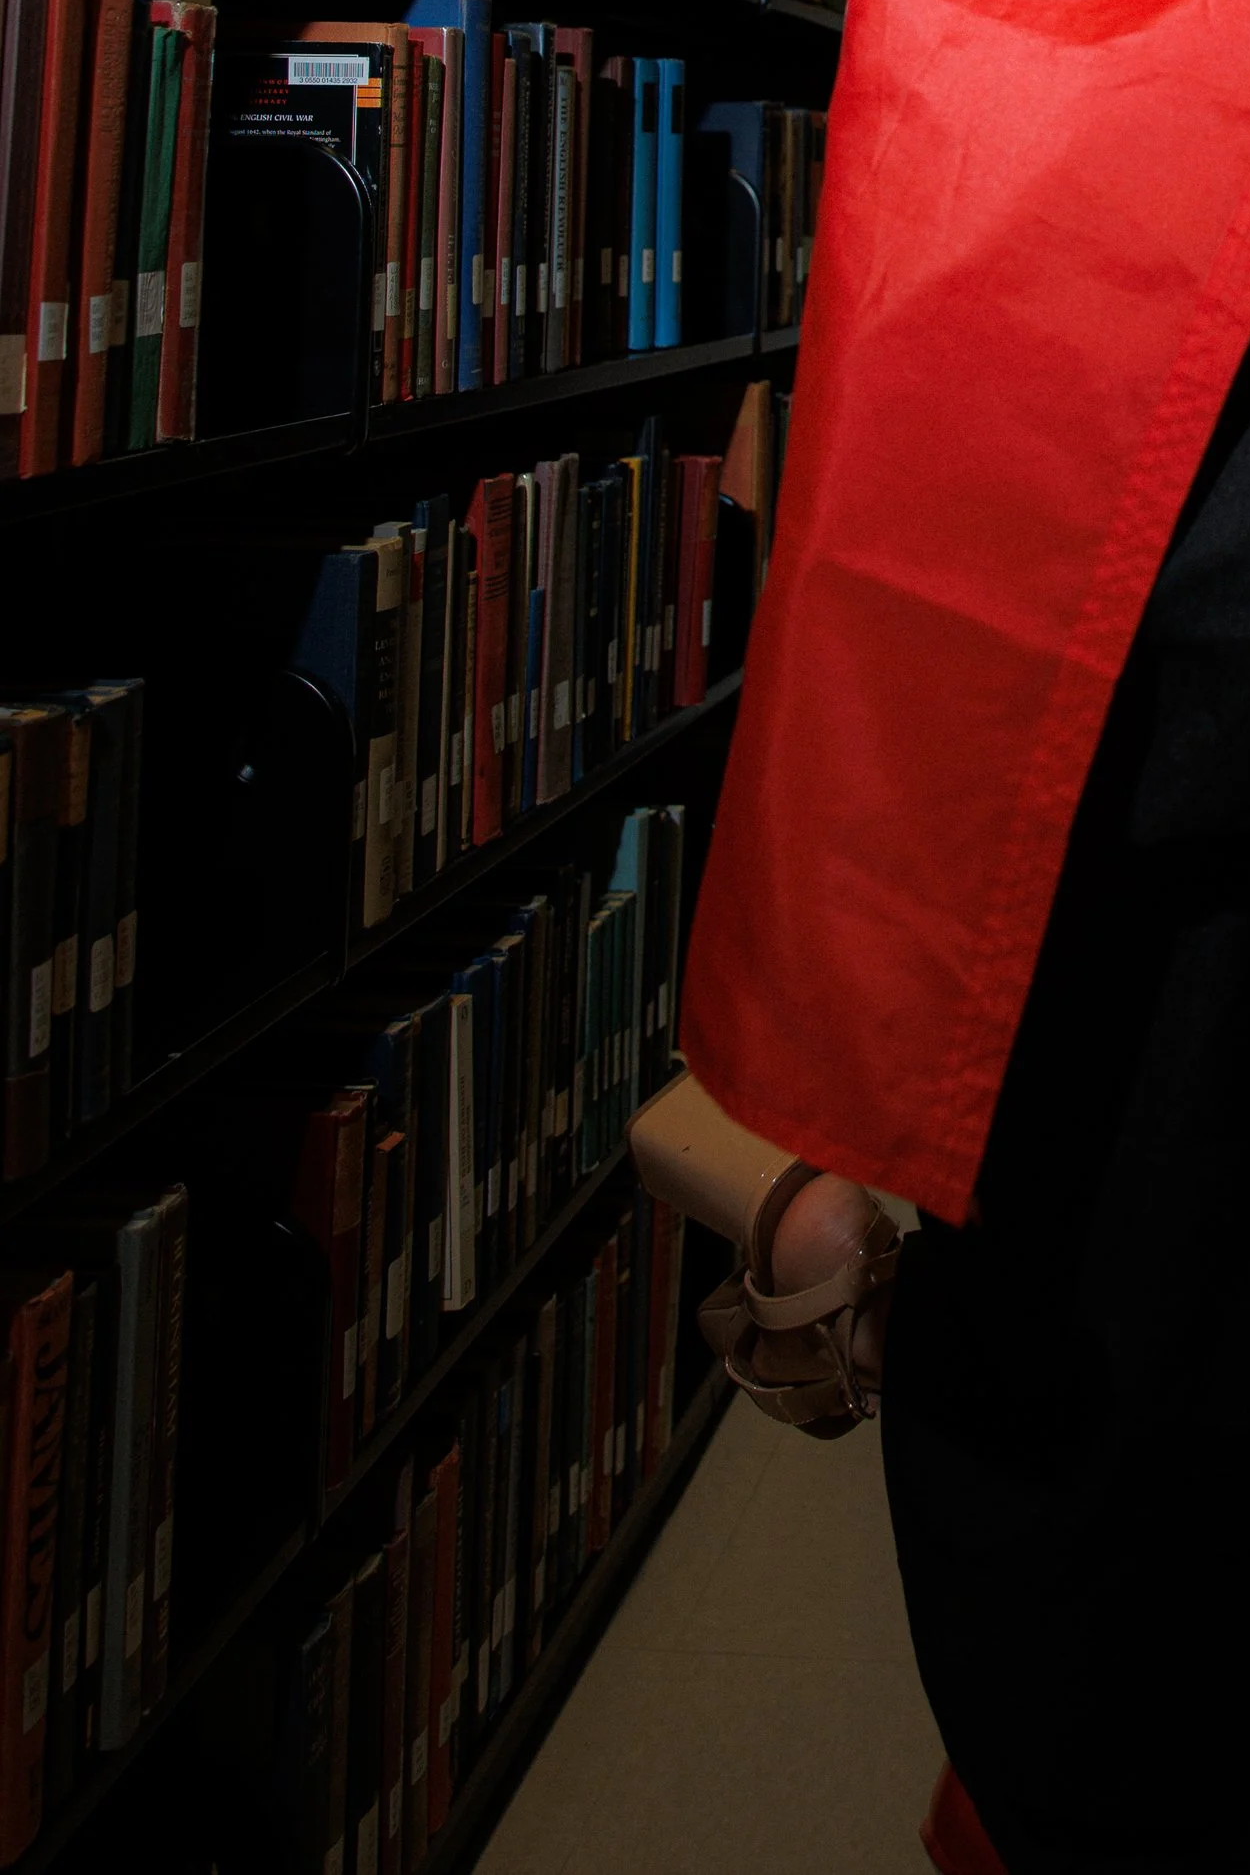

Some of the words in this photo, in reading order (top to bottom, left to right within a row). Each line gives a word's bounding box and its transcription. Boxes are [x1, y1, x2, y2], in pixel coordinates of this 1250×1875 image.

[240, 113, 273, 121] ENGLISH
[274, 113, 293, 121] CIVIL
[296, 113, 313, 121] WAR
[558, 130, 568, 193] ENGLISH
